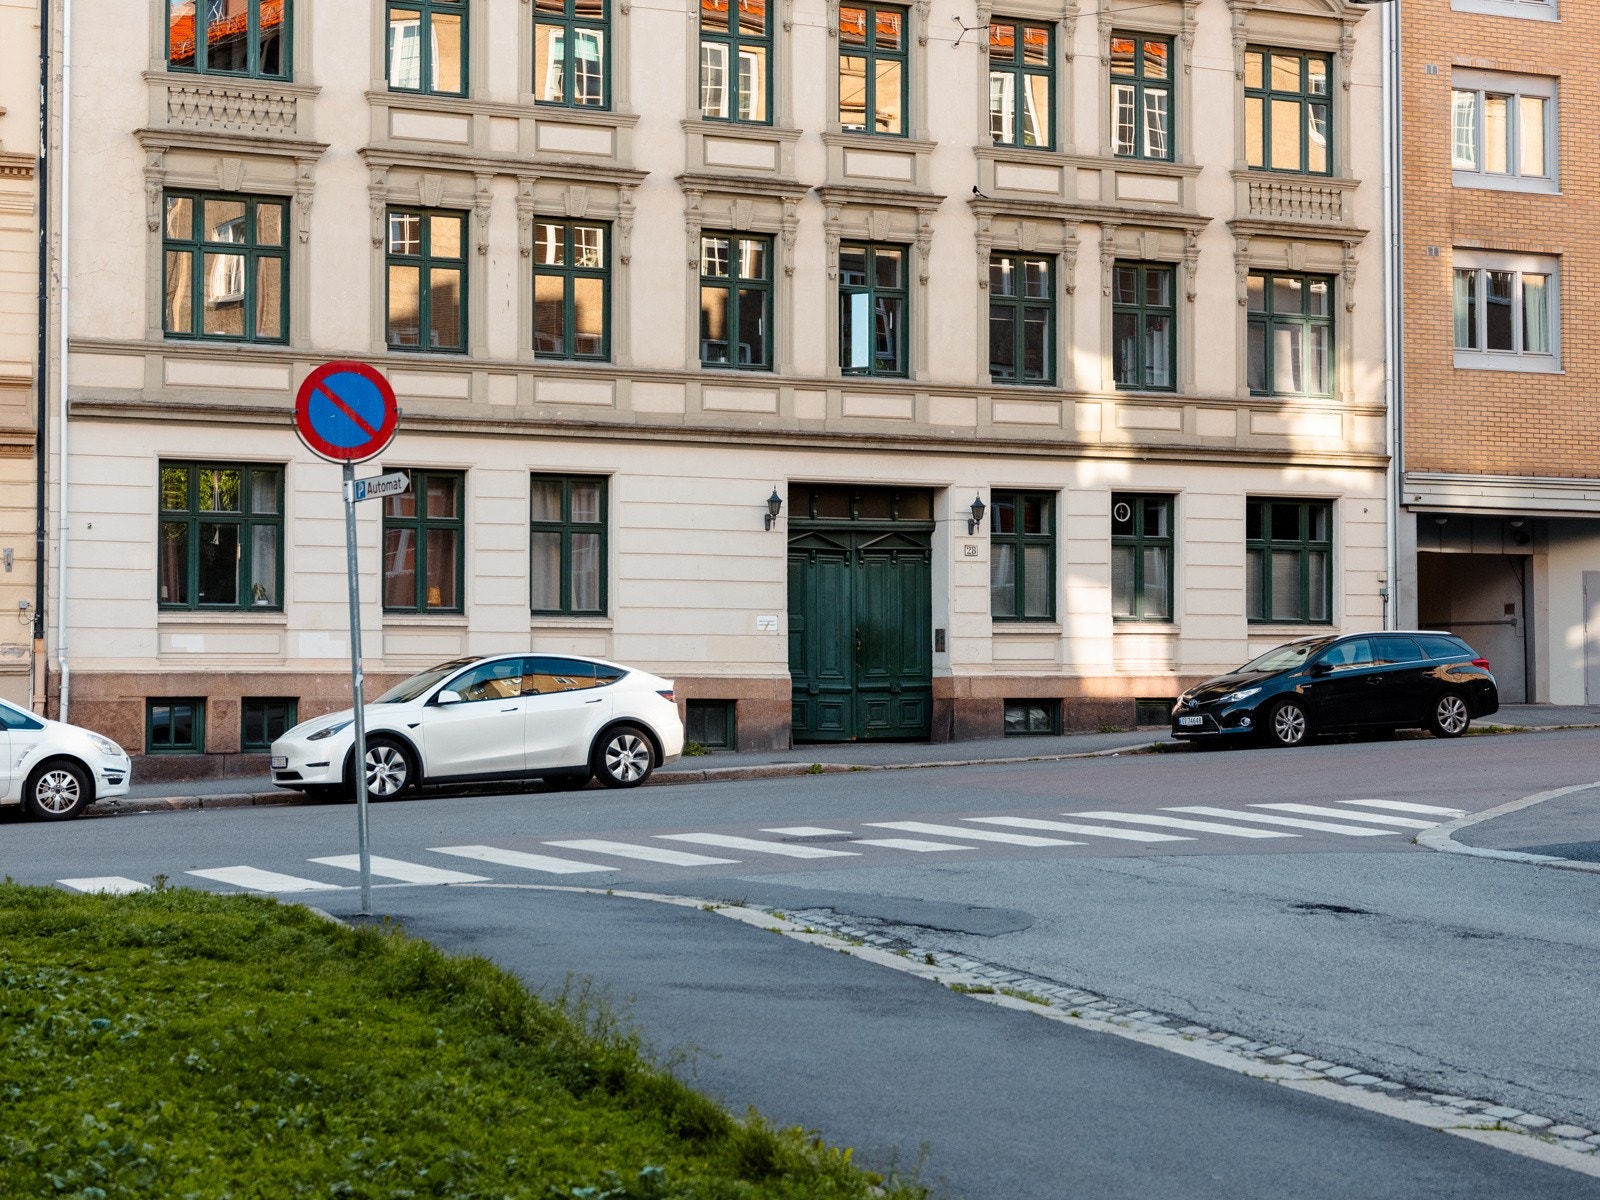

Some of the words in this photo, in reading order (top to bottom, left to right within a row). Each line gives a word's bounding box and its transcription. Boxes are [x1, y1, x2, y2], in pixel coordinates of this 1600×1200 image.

[358, 482, 365, 498] P
[367, 477, 402, 494] Automat
[966, 546, 977, 555] 28
